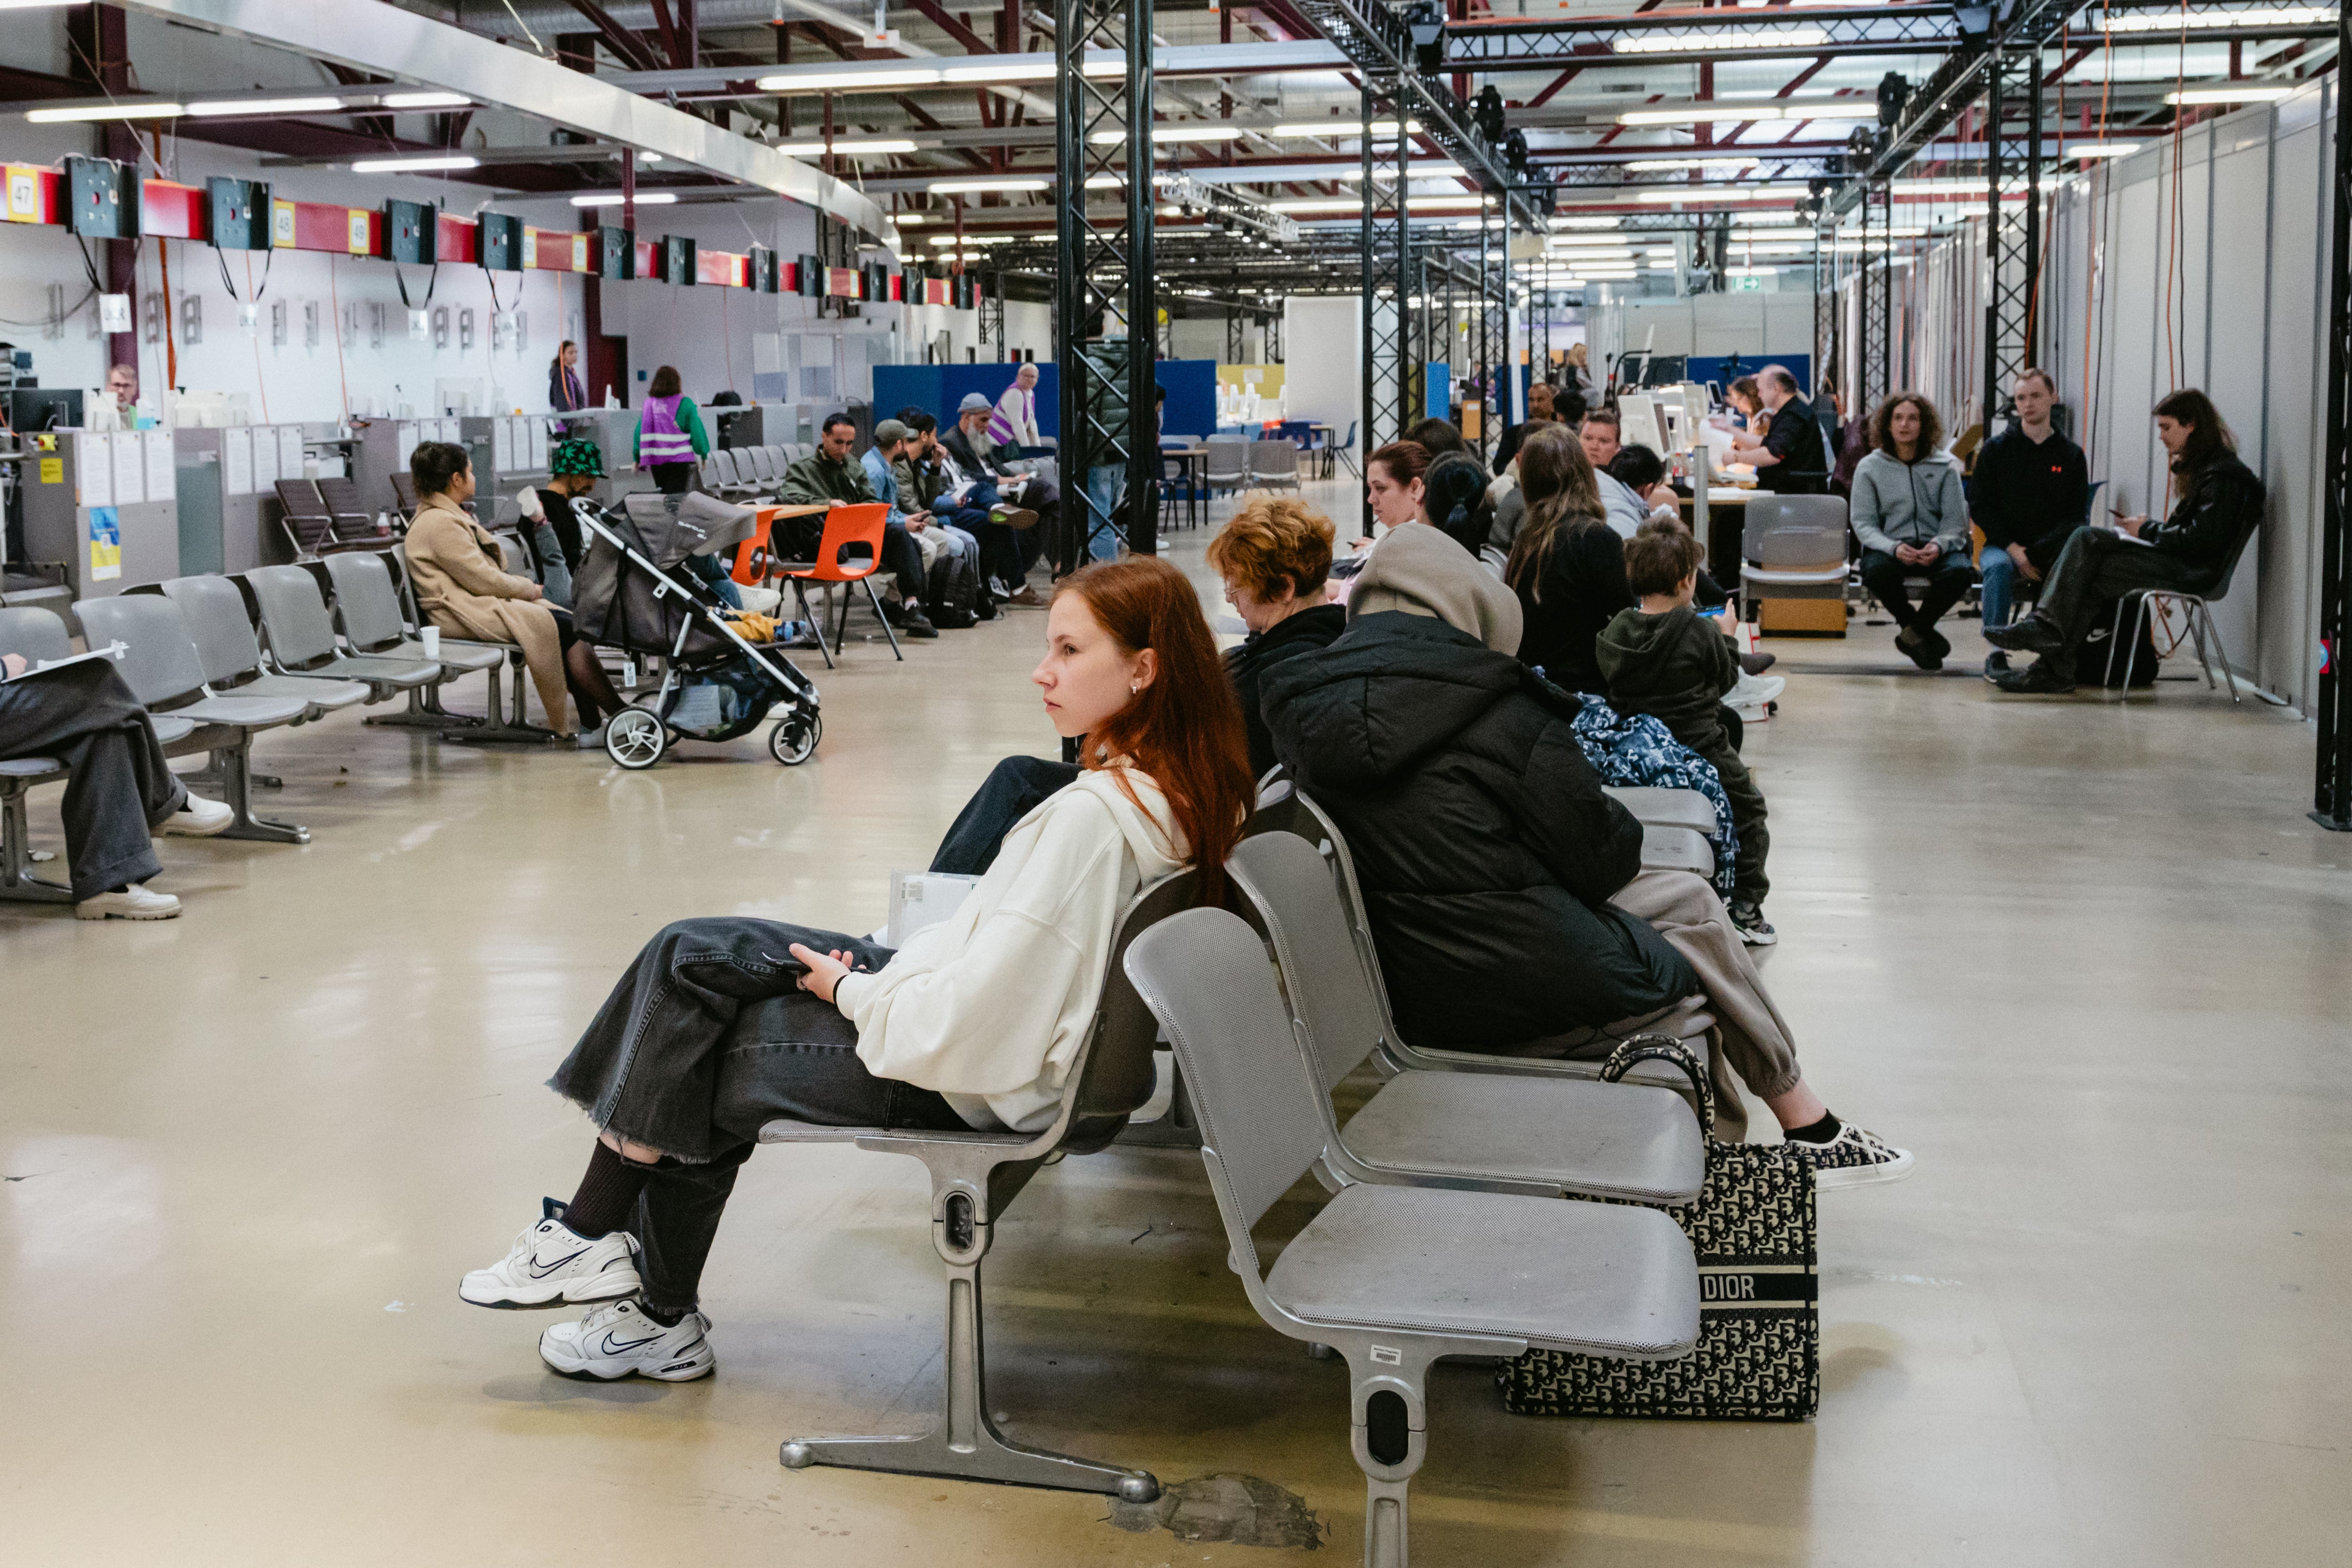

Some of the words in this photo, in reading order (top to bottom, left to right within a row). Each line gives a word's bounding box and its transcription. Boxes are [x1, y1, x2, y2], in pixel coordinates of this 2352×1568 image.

[14, 185, 30, 204] 47
[278, 216, 290, 232] 48
[354, 224, 365, 239] 49
[1704, 1275, 1755, 1299] DIOR
